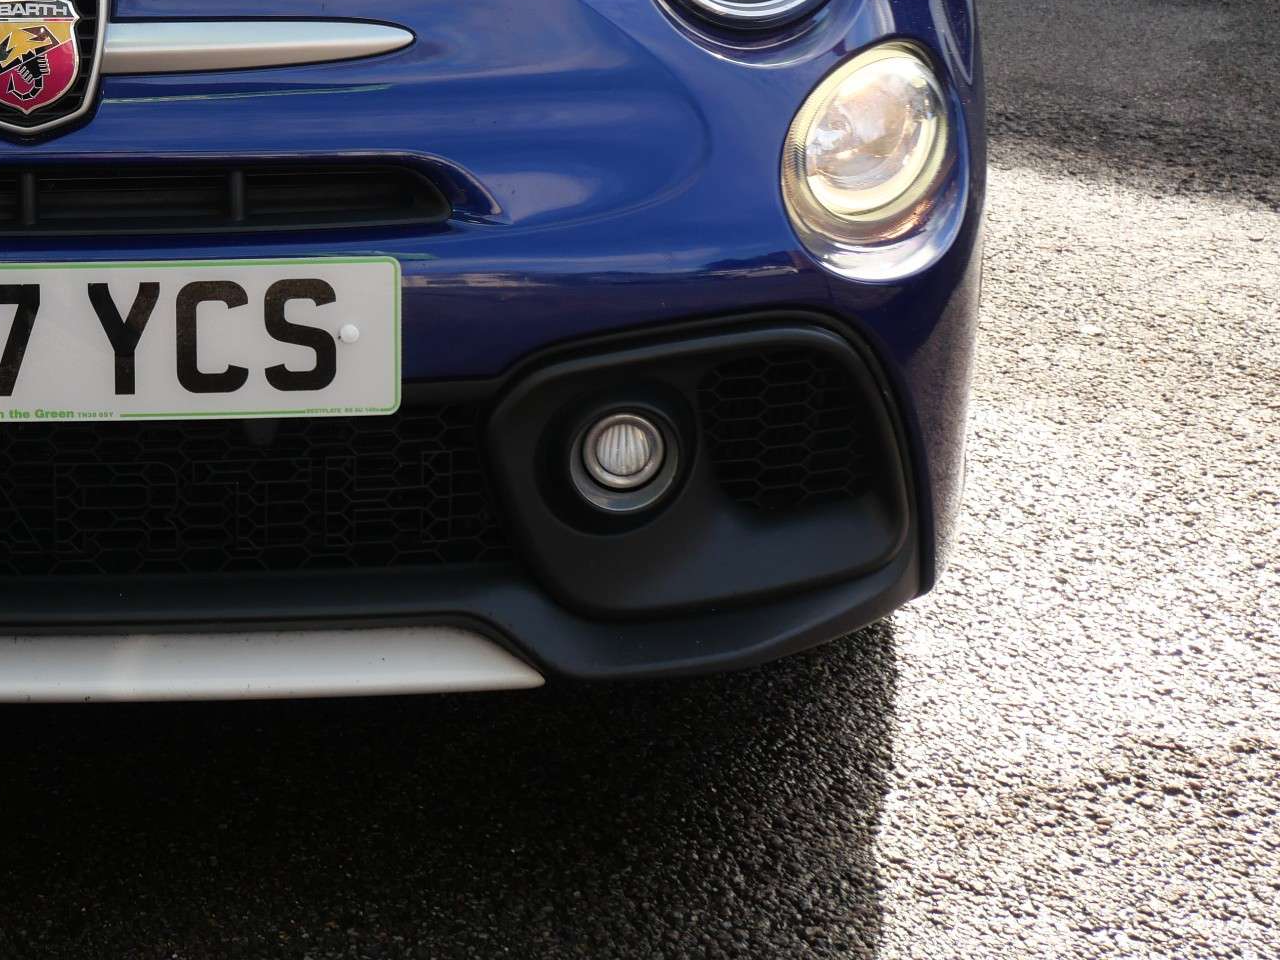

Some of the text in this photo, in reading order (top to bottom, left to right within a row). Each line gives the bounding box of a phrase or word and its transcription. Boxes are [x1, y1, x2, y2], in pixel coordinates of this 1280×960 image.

[87, 278, 337, 395] YCS
[9, 409, 30, 419] the
[34, 409, 74, 418] Green
